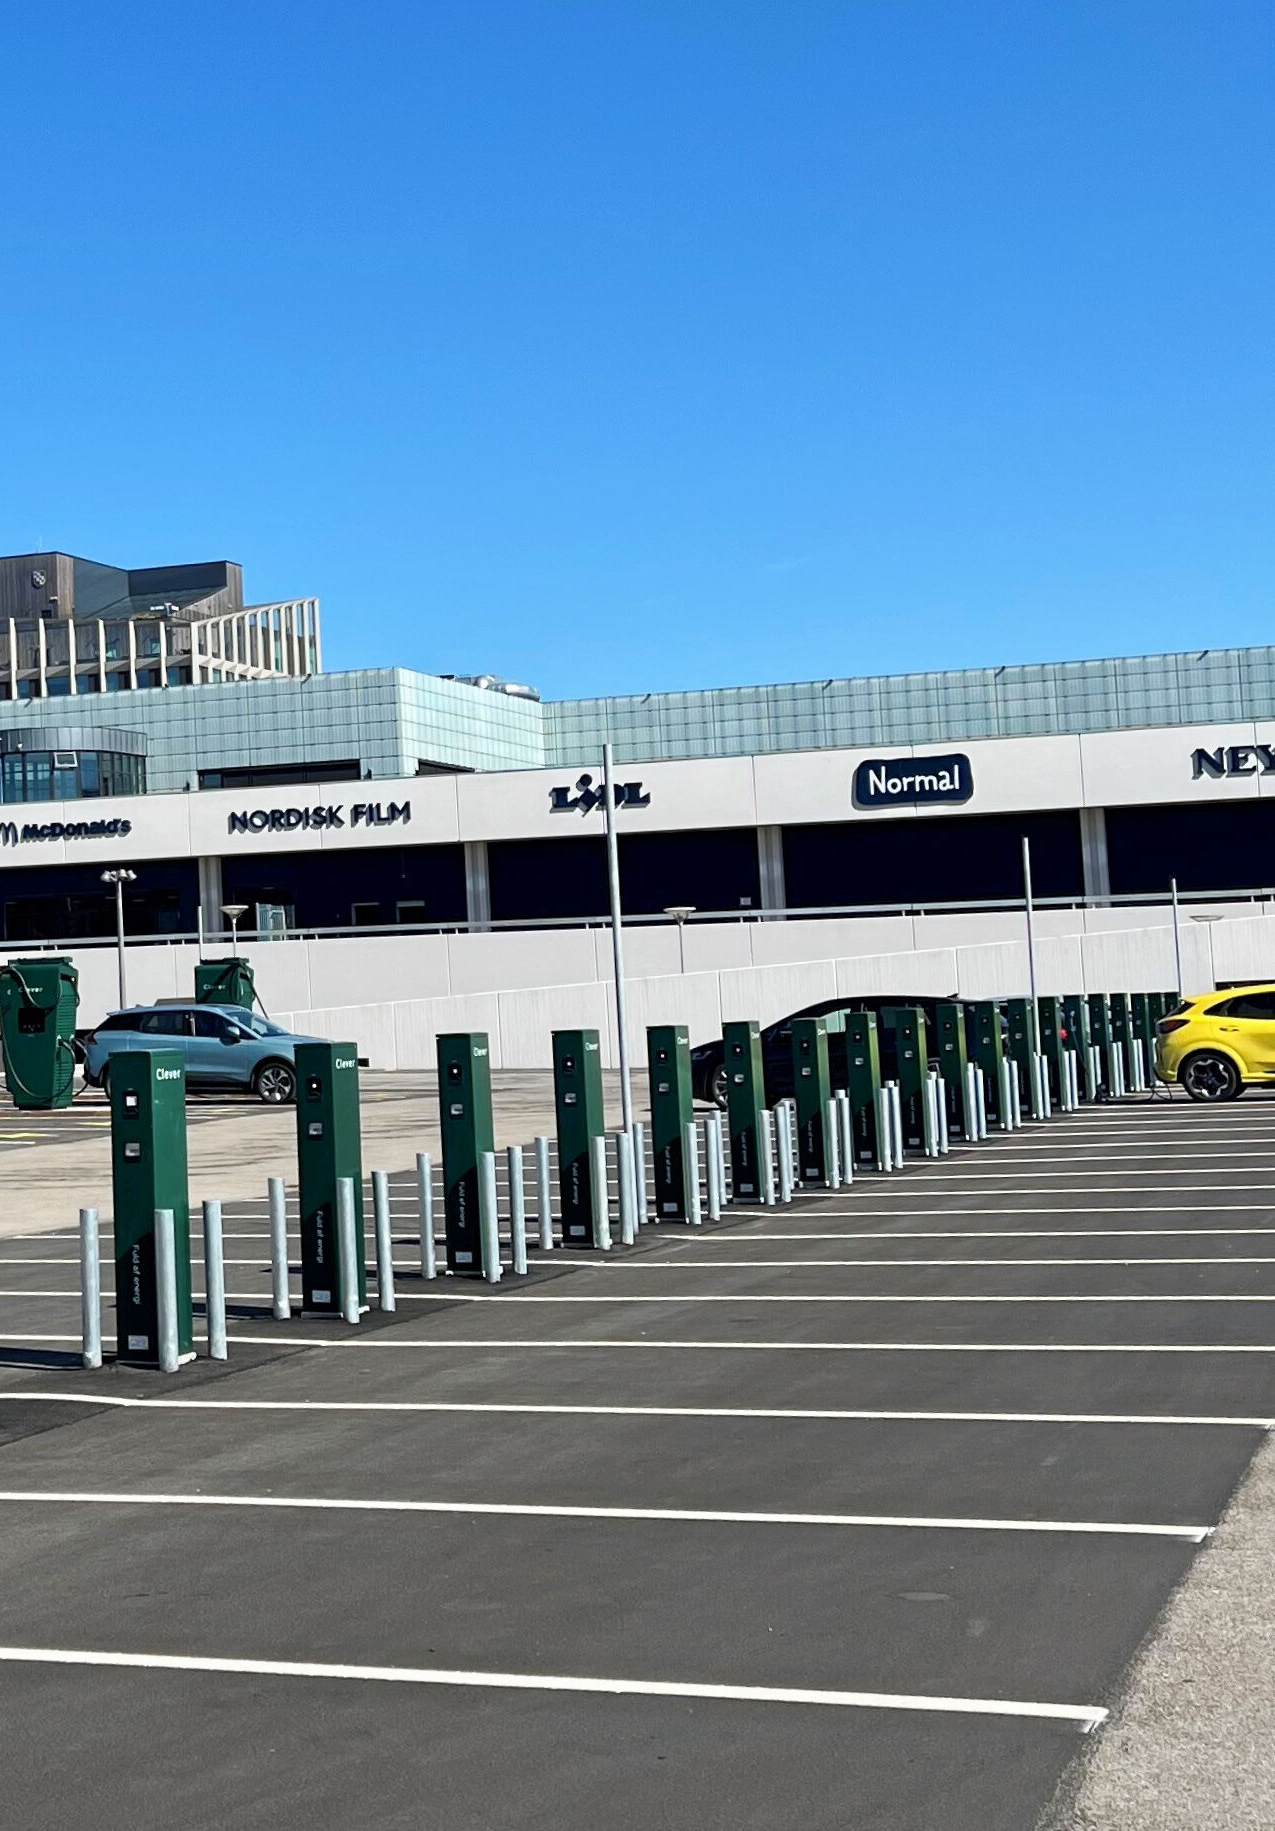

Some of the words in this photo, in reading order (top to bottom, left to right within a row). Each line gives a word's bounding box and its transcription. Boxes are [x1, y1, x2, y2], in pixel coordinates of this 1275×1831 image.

[869, 764, 960, 795] Normal
[228, 806, 345, 834] NORDISK
[351, 801, 411, 828] FILM
[20, 819, 132, 843] McDonald's
[156, 1068, 181, 1081] Clever
[335, 1058, 356, 1070] Clever
